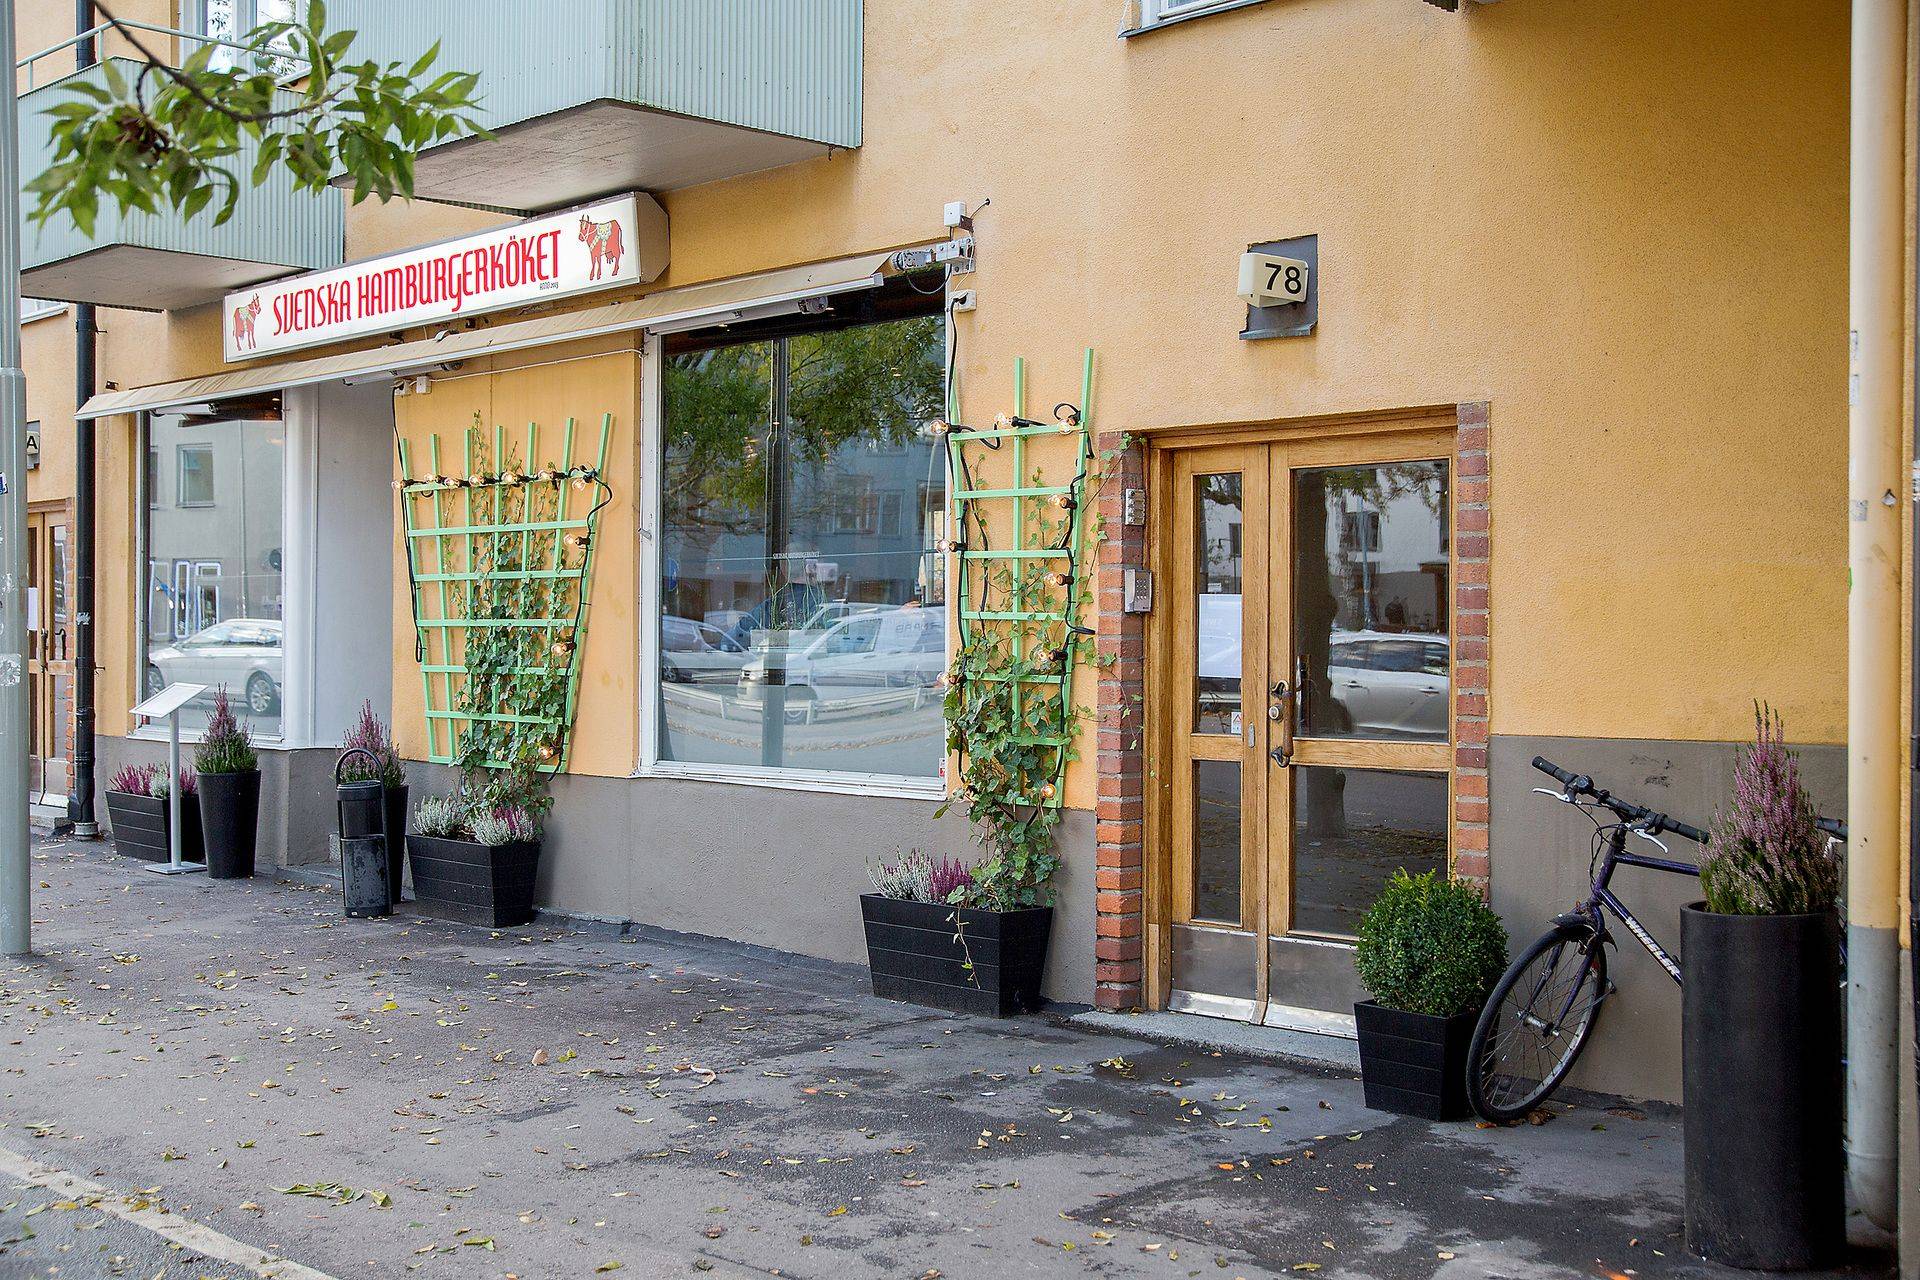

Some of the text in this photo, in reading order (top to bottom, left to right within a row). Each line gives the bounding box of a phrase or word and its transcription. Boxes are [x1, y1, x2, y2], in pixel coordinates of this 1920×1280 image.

[273, 230, 561, 336] SVENSKA HAMBURGERKÖKET
[1265, 262, 1302, 294] 78
[1625, 916, 1681, 976] WHEELER
